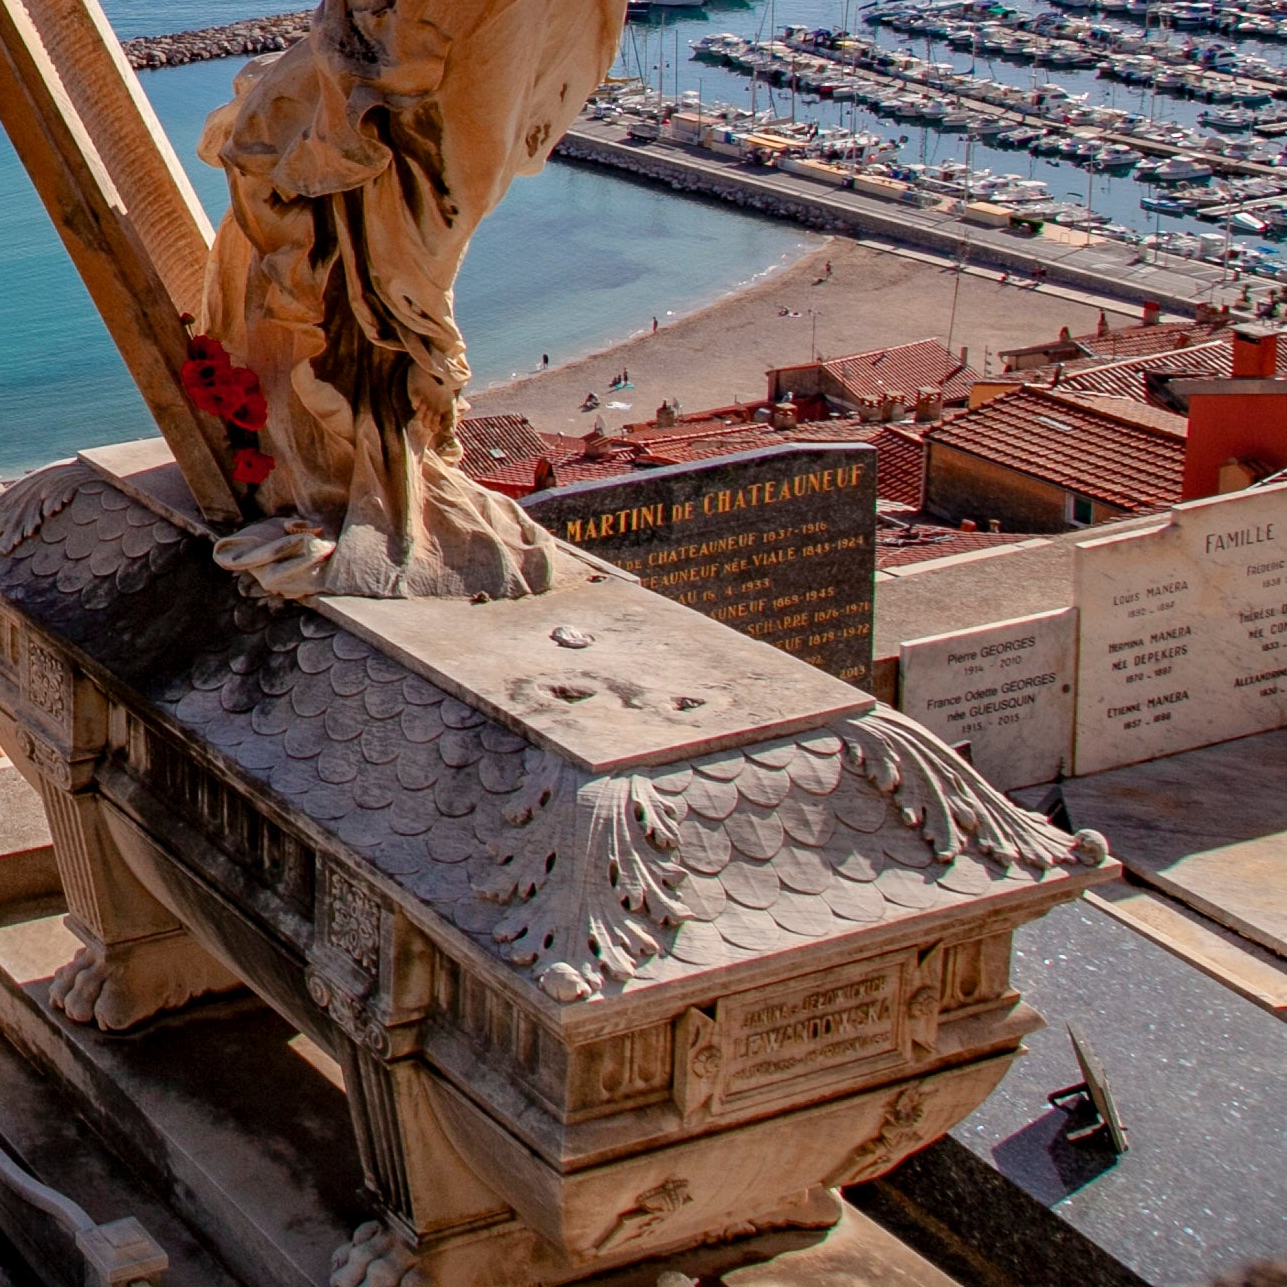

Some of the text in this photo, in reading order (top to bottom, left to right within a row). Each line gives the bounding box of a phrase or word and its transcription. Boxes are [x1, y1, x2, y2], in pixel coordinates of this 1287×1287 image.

[566, 463, 865, 543] MARTINI DE CHATEAUNEUF
[626, 559, 643, 572] DE
[648, 532, 757, 566] CHATEAUNEUF
[1206, 523, 1275, 554] FAMILLE
[723, 557, 749, 574] NÉE
[752, 546, 796, 567] VIALE
[1113, 581, 1189, 606] LOUIS MANERA
[947, 636, 1036, 665] Pierre GEORGES
[1108, 625, 1192, 654] HERMINA MANERA
[963, 665, 984, 676] 1914
[999, 656, 1023, 669] 2010
[1134, 644, 1189, 666] DEPEKERS
[926, 673, 1057, 711] France Odette GEORGES
[1147, 690, 1190, 708] MANERA
[947, 695, 1035, 722] née GUEUSQUIN
[961, 722, 982, 733] 1915
[998, 714, 1020, 726] 2015
